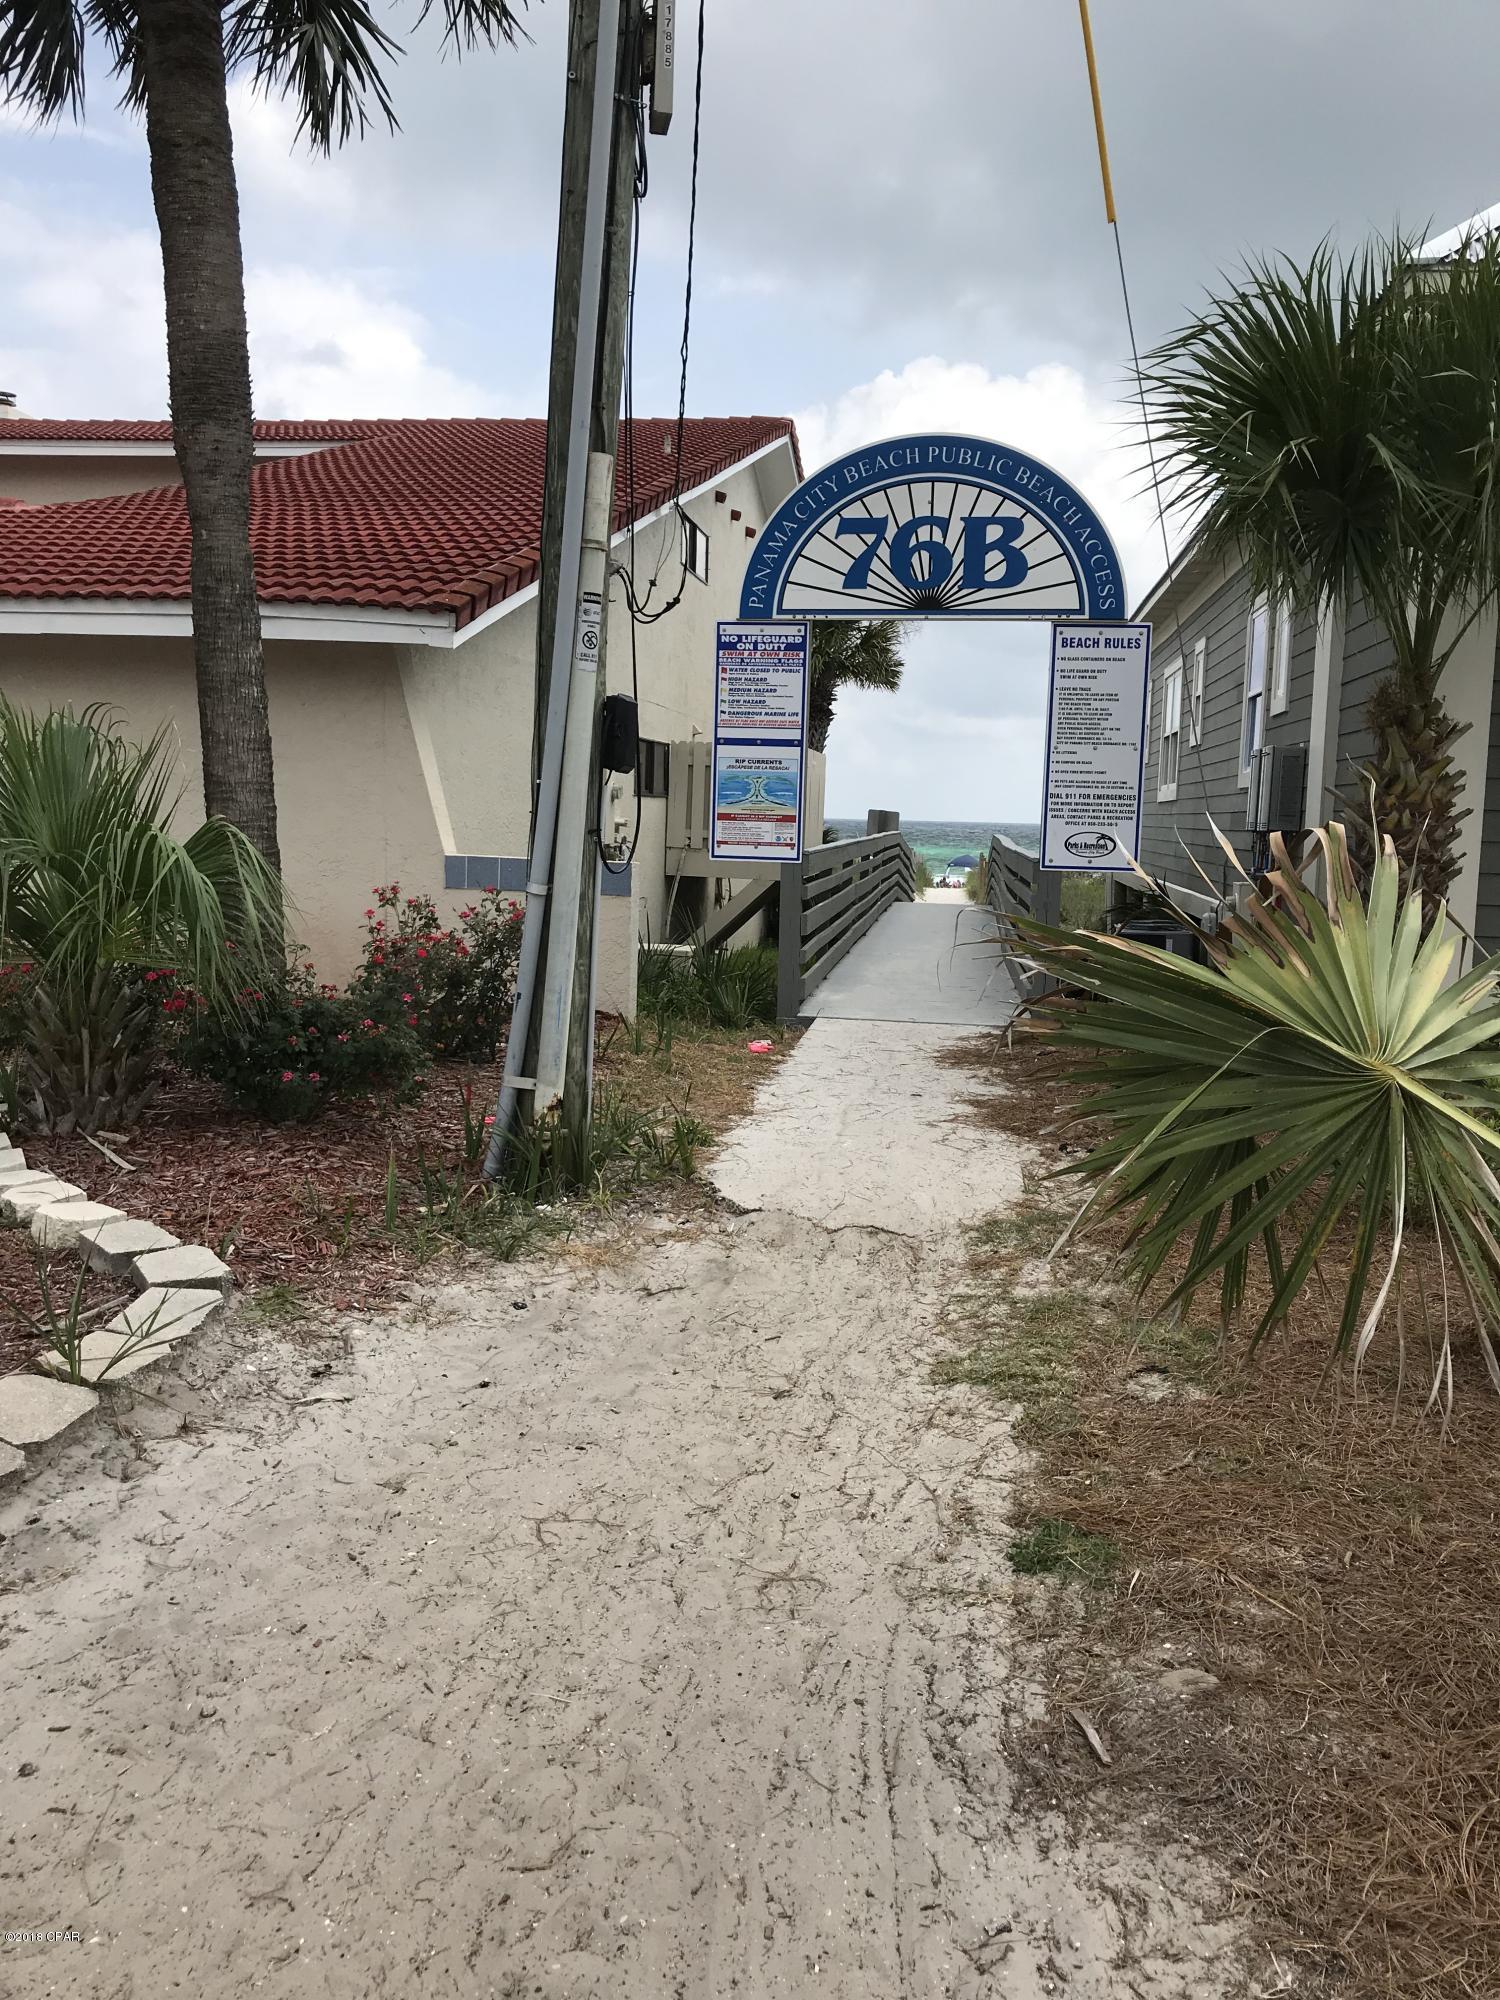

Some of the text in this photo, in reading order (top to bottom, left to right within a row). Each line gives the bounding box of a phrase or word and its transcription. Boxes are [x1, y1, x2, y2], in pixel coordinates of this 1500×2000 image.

[749, 446, 1116, 610] PANAMA CITY BEACH PUBLIC BEACH ACCESS
[834, 514, 1029, 590] 76B
[1061, 637, 1141, 649] BEACH RULES
